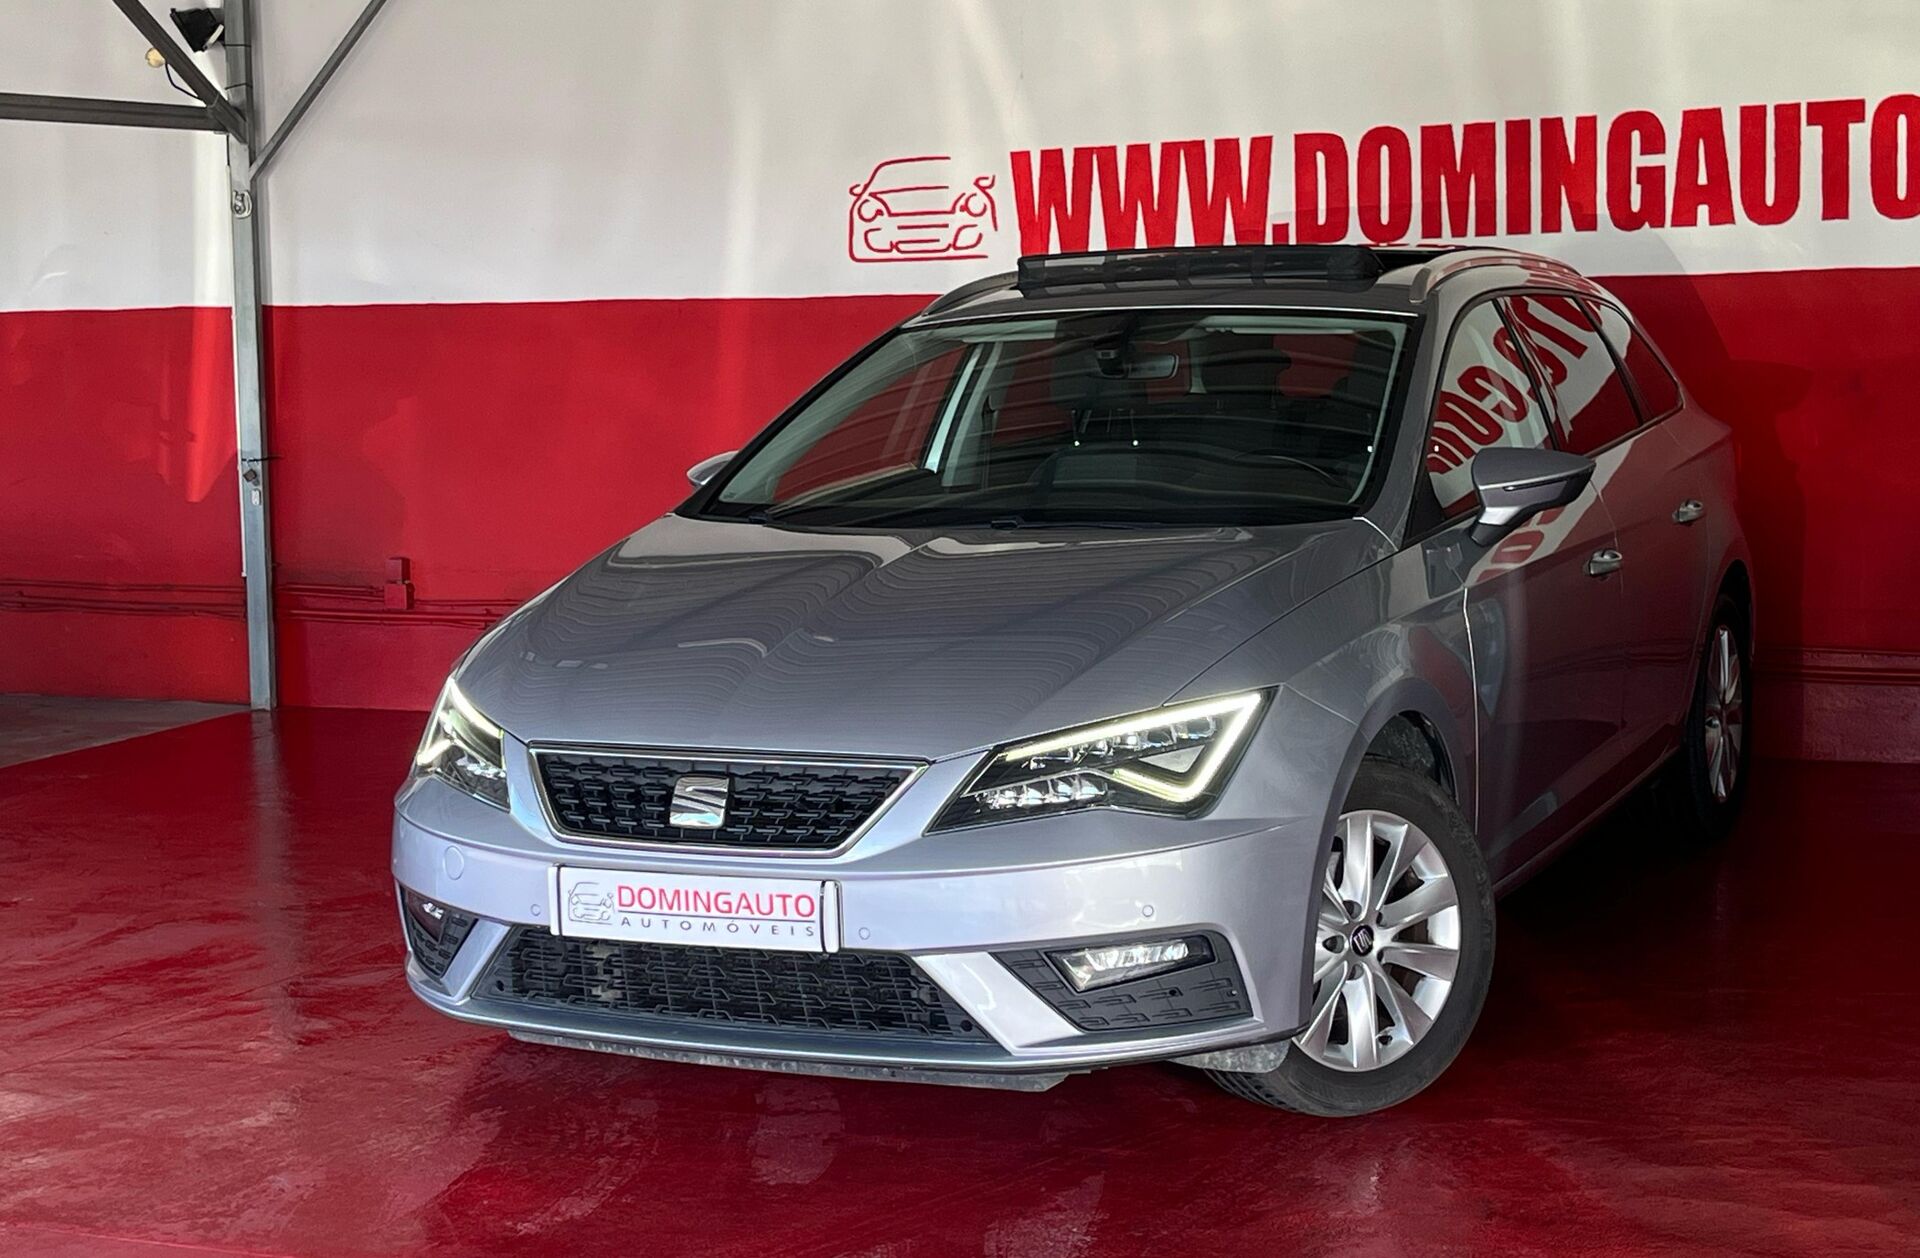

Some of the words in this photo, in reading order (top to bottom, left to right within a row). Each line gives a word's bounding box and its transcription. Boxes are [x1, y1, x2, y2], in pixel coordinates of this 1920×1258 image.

[1010, 93, 1920, 257] WWW.DOMINGAUTO
[617, 885, 815, 918] DOMINGAUTO
[621, 916, 815, 937] AUTOMÓVEIS
